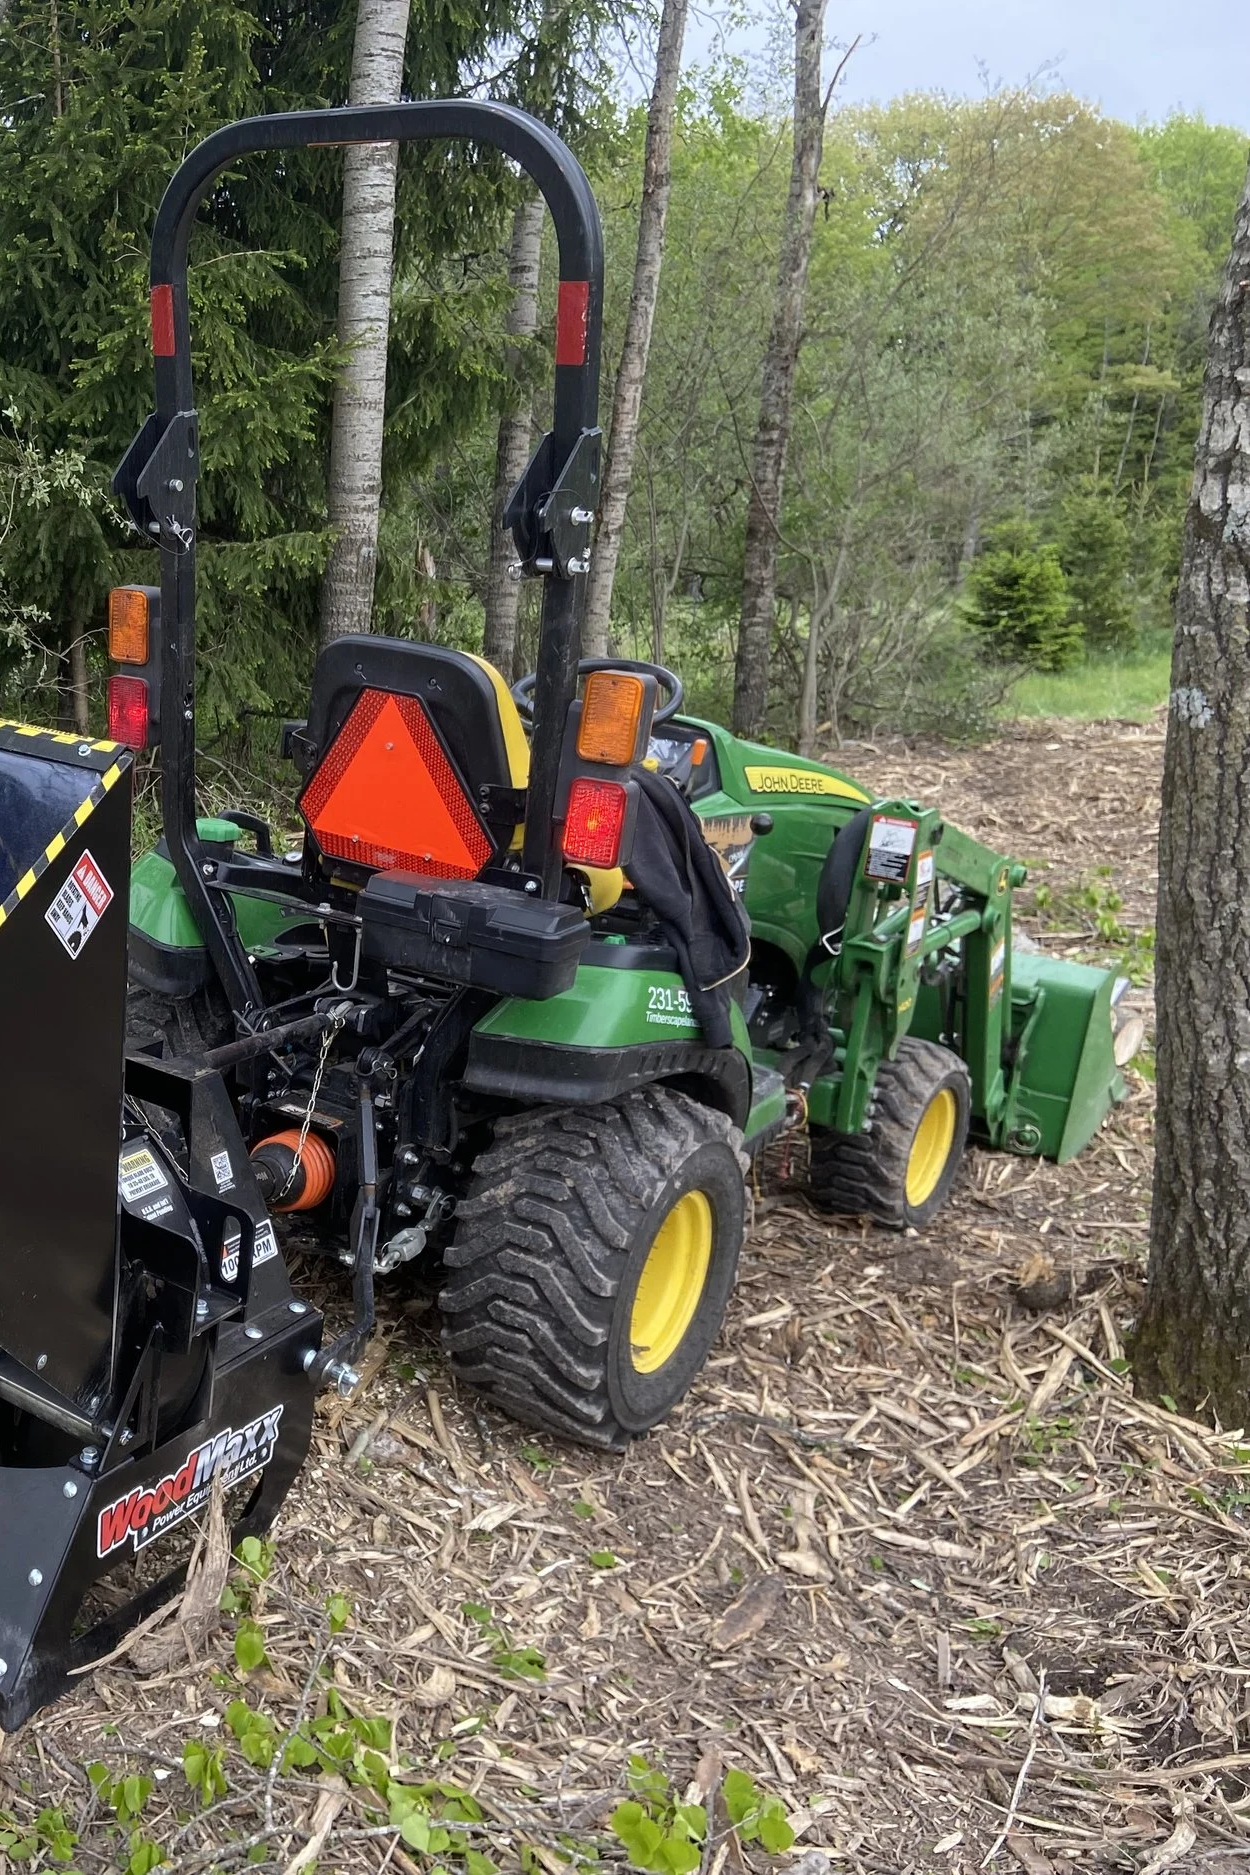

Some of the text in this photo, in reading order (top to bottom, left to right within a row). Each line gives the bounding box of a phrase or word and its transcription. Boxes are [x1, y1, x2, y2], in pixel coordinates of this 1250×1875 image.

[758, 773, 824, 791] JOHN DEERE
[67, 880, 82, 903] ROTATING
[82, 870, 107, 910] DANGER
[56, 899, 66, 912] KEEP
[122, 1154, 151, 1173] WARNING
[253, 1238, 272, 1258] PM
[152, 1501, 185, 1532] Power
[239, 1453, 257, 1473] Ltd.
